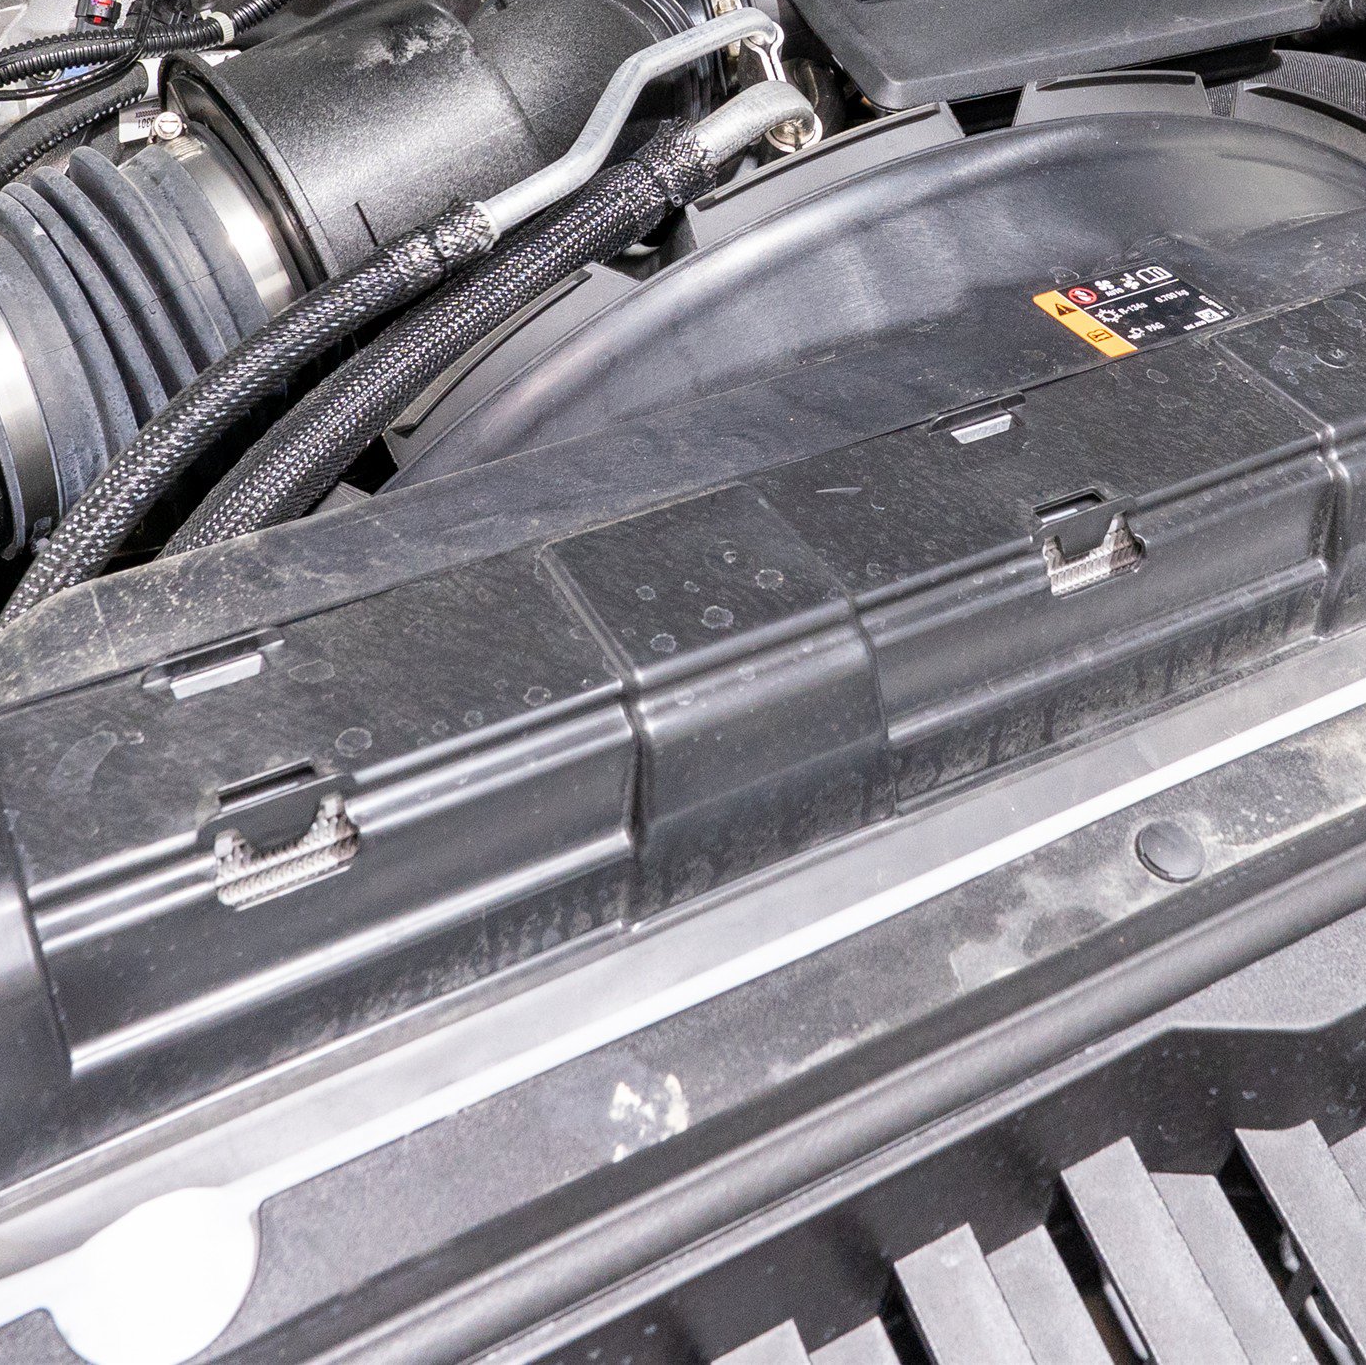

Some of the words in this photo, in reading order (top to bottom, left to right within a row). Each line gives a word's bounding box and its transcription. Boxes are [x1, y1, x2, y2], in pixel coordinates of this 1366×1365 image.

[1105, 287, 1125, 298] AUTO
[1118, 302, 1148, 315] R-134a
[1176, 288, 1190, 299] kg
[1146, 322, 1166, 333] PAG
